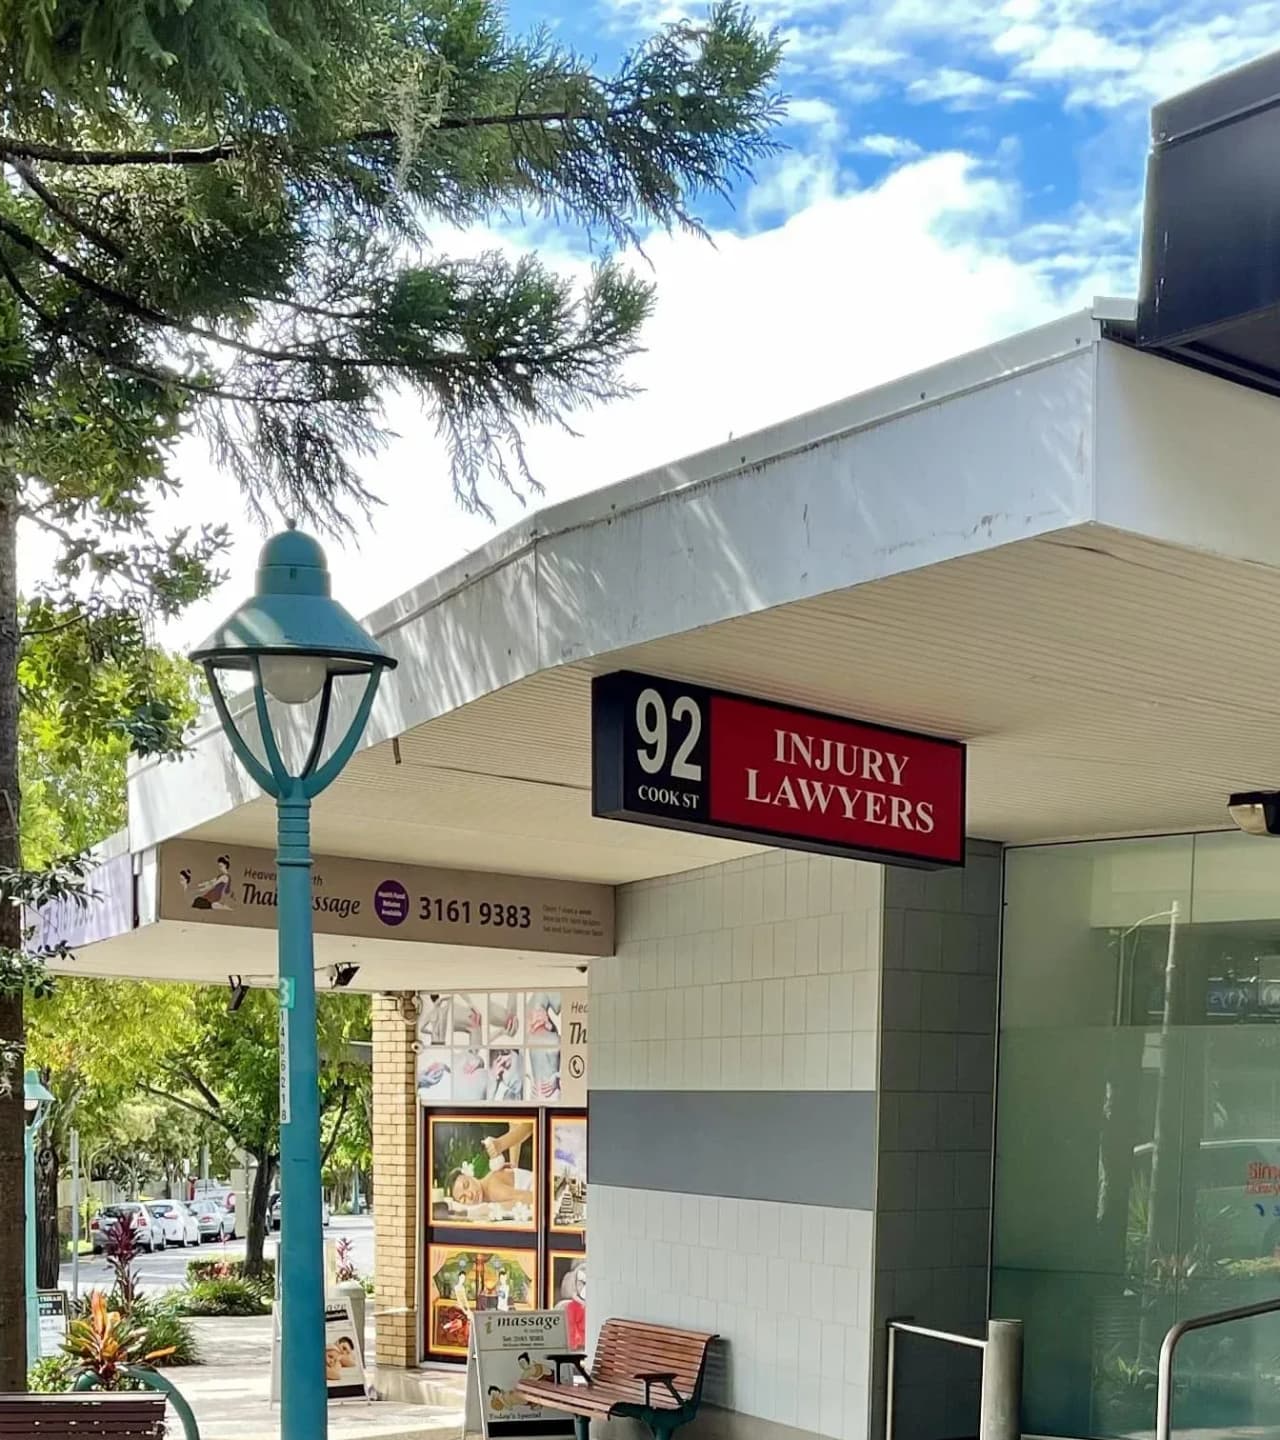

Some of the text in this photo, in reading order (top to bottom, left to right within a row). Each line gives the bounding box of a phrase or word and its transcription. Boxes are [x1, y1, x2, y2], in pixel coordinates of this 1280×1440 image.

[635, 688, 702, 782] 92
[774, 729, 909, 786] INJURY
[638, 785, 700, 809] COOK ST
[745, 768, 934, 833] LAWYERS
[242, 883, 278, 906] Thai
[419, 897, 471, 923] 3161
[479, 902, 531, 928] 9383
[497, 1315, 561, 1330] massage
